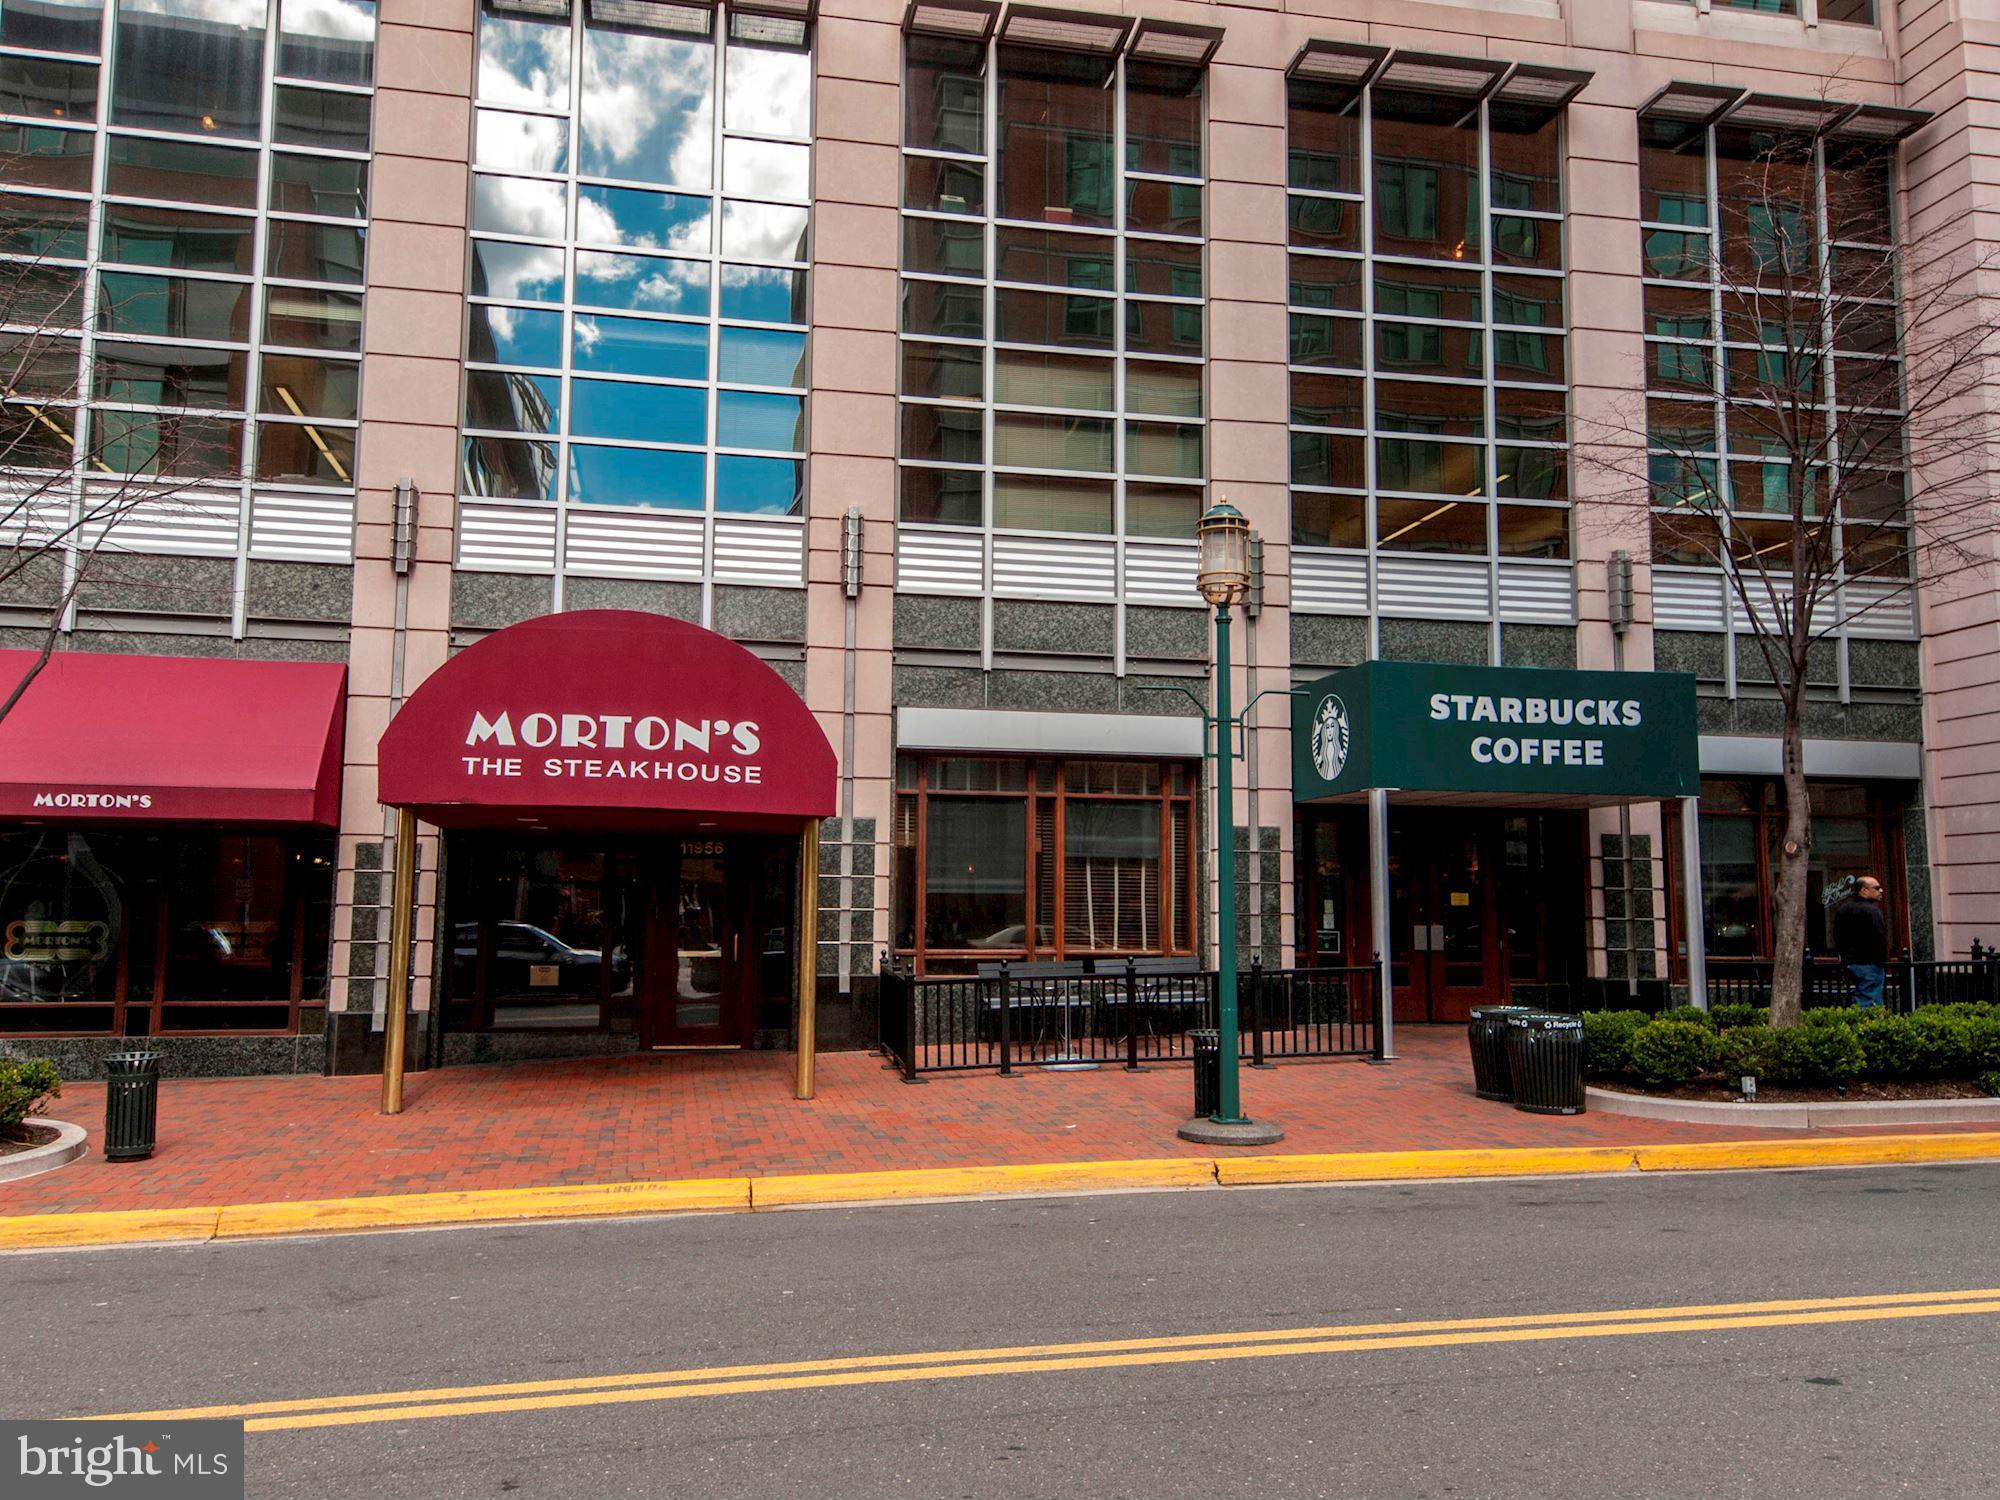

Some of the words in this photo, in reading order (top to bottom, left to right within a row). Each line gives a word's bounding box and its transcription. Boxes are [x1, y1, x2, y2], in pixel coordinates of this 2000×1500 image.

[1430, 693, 1643, 727] STARBUCKS
[464, 709, 762, 756] MORTON'S
[1470, 736, 1604, 766] COFFEE
[461, 757, 523, 777] THE
[543, 757, 762, 785] STEAKHOUSE
[32, 792, 152, 809] MORTON'S
[680, 841, 724, 855] 11956
